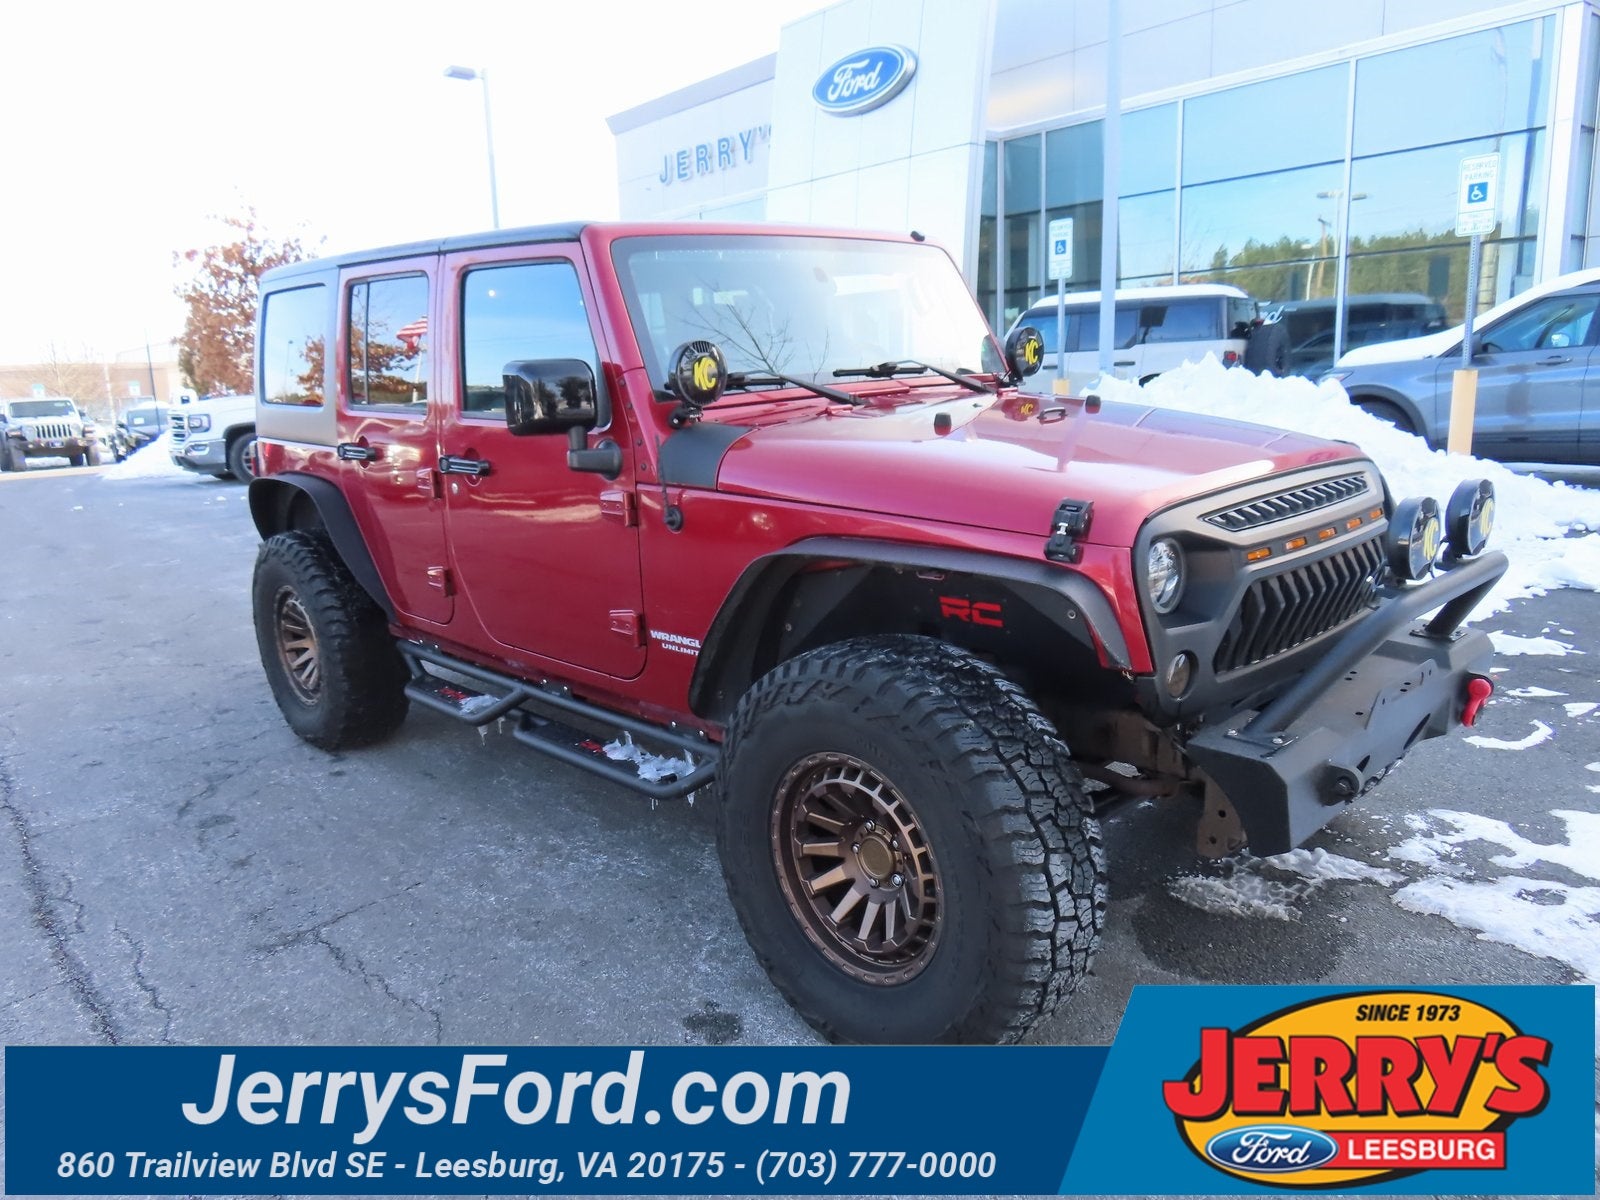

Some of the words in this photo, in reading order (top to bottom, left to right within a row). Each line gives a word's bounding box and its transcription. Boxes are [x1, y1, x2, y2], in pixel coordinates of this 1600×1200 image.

[827, 58, 883, 102] Ford
[1025, 340, 1039, 365] KC
[694, 357, 717, 390] KC
[939, 596, 1003, 627] RC
